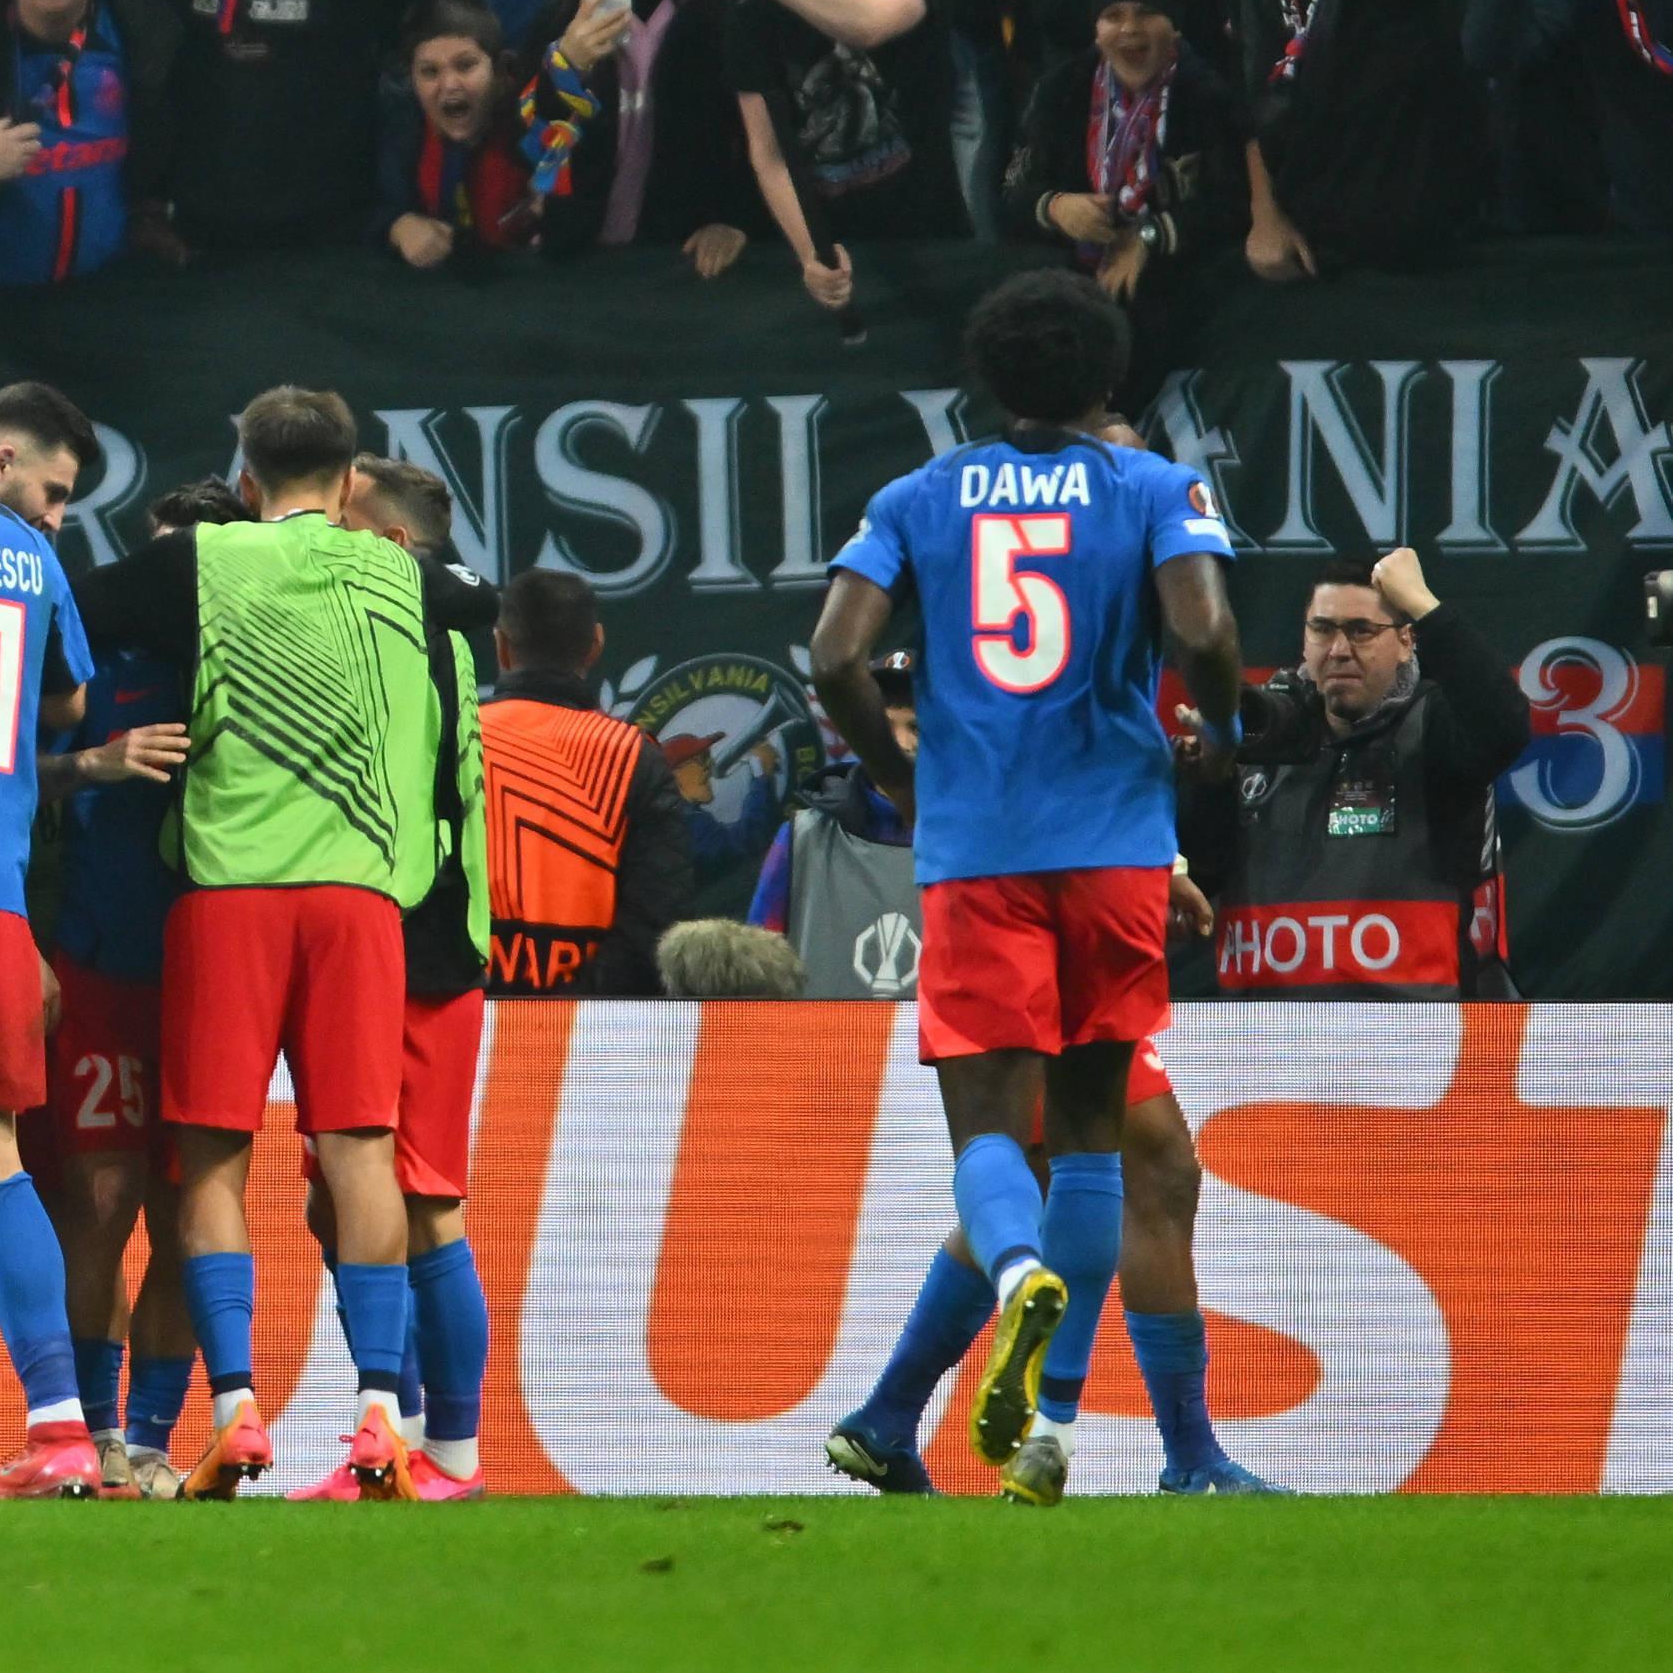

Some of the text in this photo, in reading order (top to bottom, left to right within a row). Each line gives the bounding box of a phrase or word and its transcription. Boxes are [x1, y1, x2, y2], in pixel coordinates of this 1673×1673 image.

[960, 463, 1090, 507] DAWA
[971, 512, 1071, 695] 5
[1510, 636, 1640, 830] 3
[75, 1055, 143, 1128] 25
